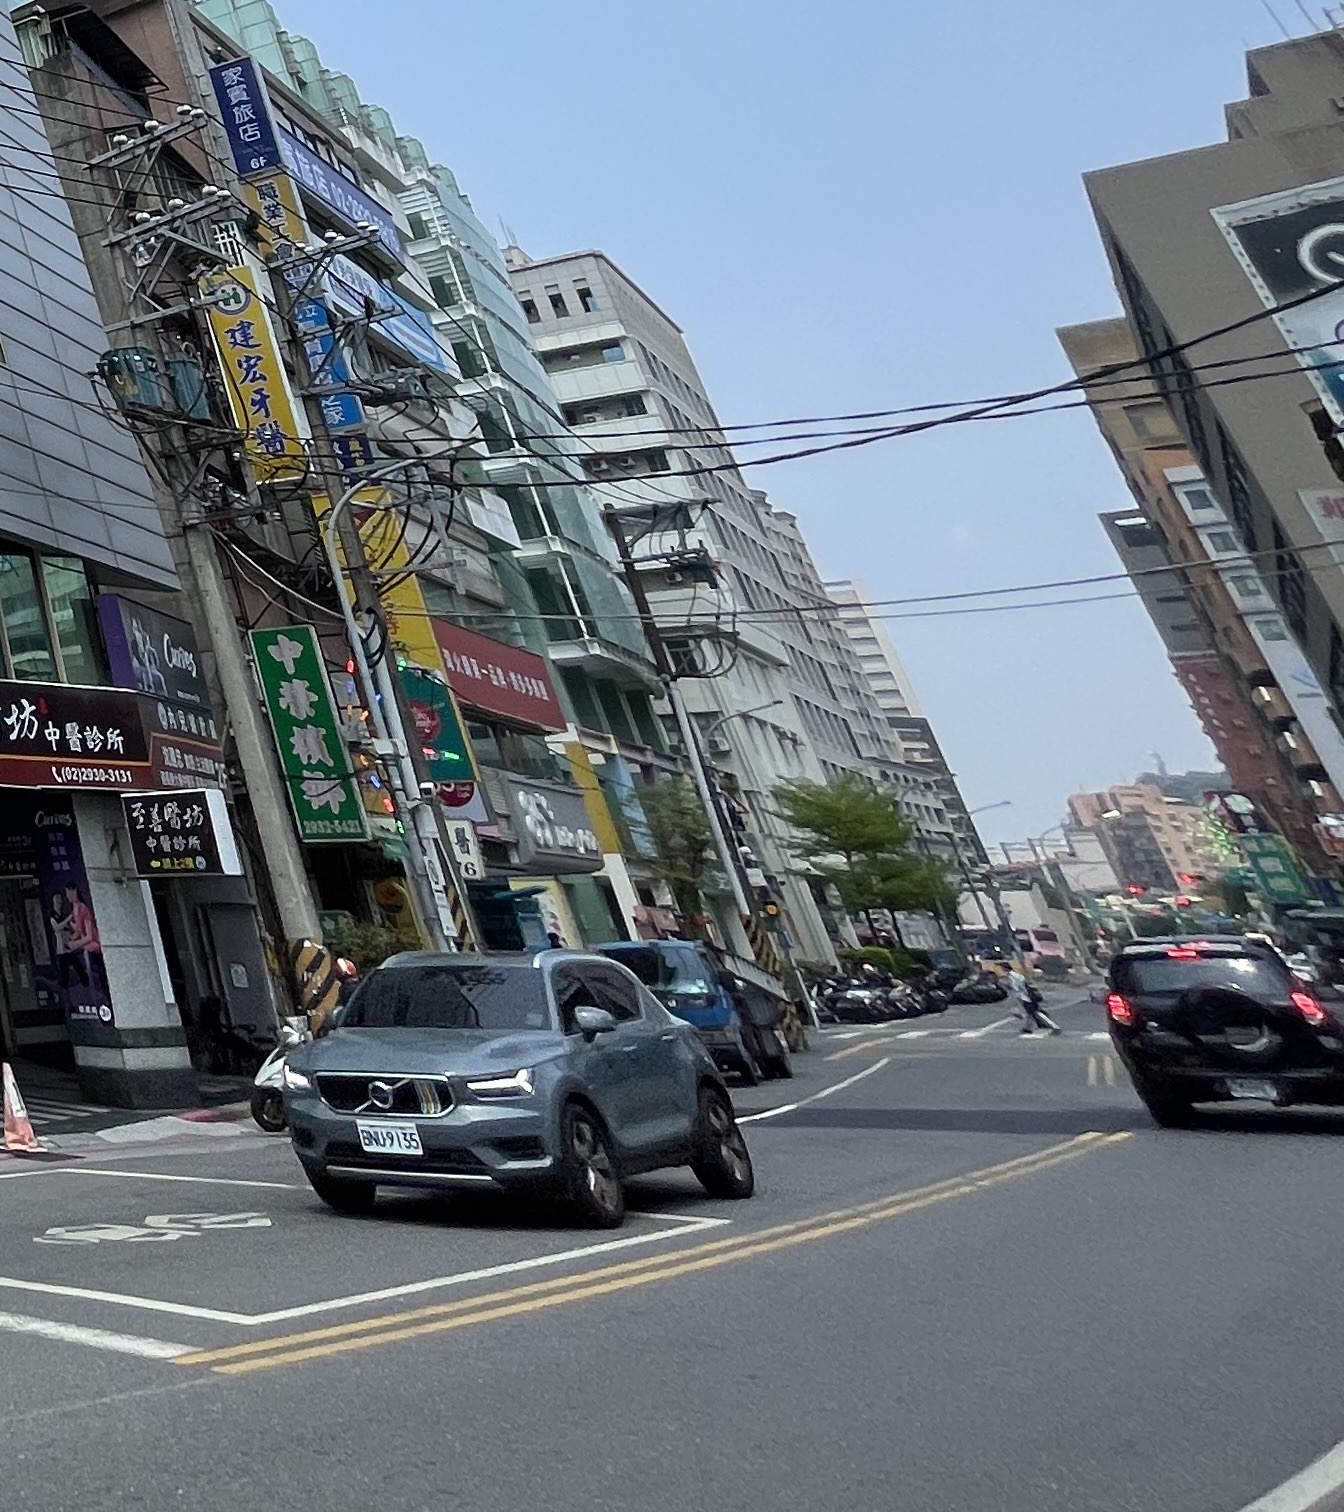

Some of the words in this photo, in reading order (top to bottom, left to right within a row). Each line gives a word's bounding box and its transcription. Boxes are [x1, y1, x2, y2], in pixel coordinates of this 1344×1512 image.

[220, 66, 262, 142] 家賓旅店
[224, 320, 289, 455] 建宏牙醫
[44, 720, 125, 755] 中醫診所
